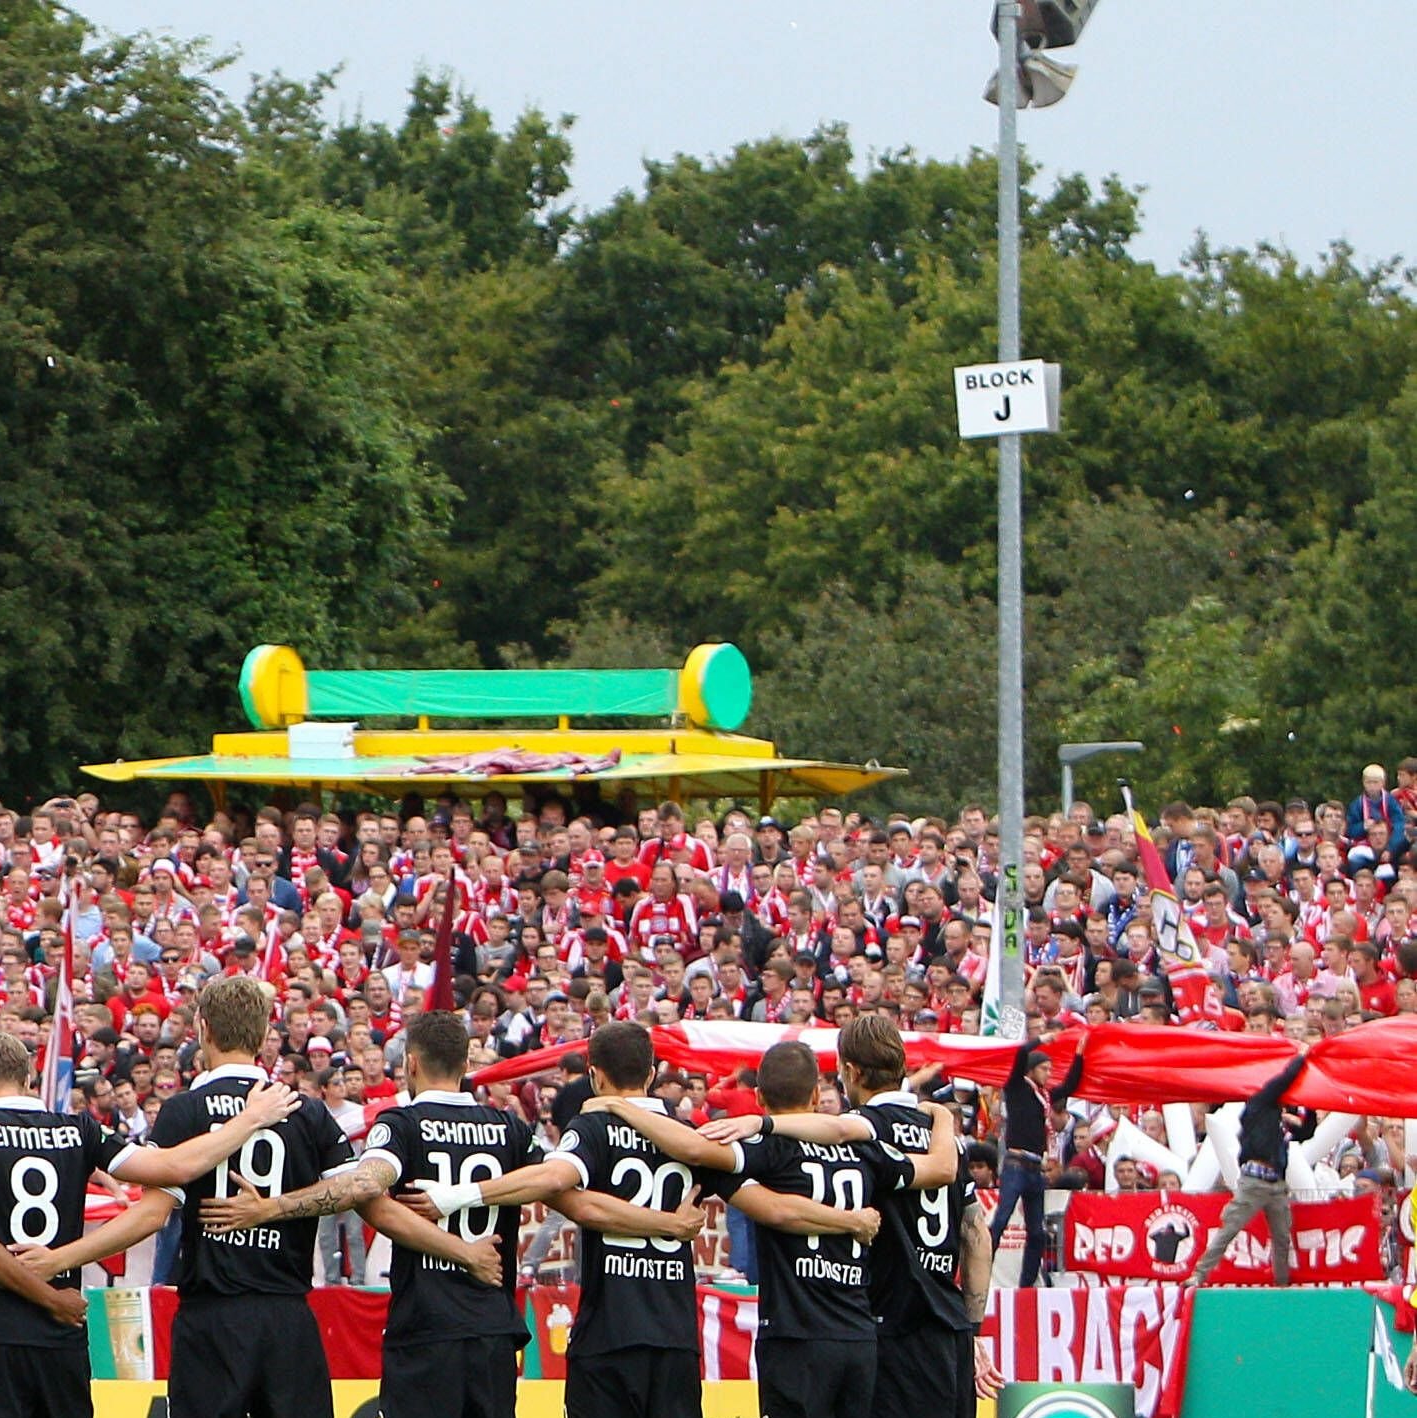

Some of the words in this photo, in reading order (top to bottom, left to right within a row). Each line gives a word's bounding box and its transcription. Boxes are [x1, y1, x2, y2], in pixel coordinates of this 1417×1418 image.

[966, 368, 1034, 389] BLOCK
[994, 395, 1011, 421] J
[420, 1119, 507, 1146] SCHMIDT
[10, 1156, 59, 1247] 8
[602, 1158, 693, 1253] 20
[917, 1185, 949, 1247] 9
[1074, 1222, 1135, 1262] RED
[604, 1253, 685, 1281] MÜNSTER
[796, 1254, 863, 1286] MÜNSTER
